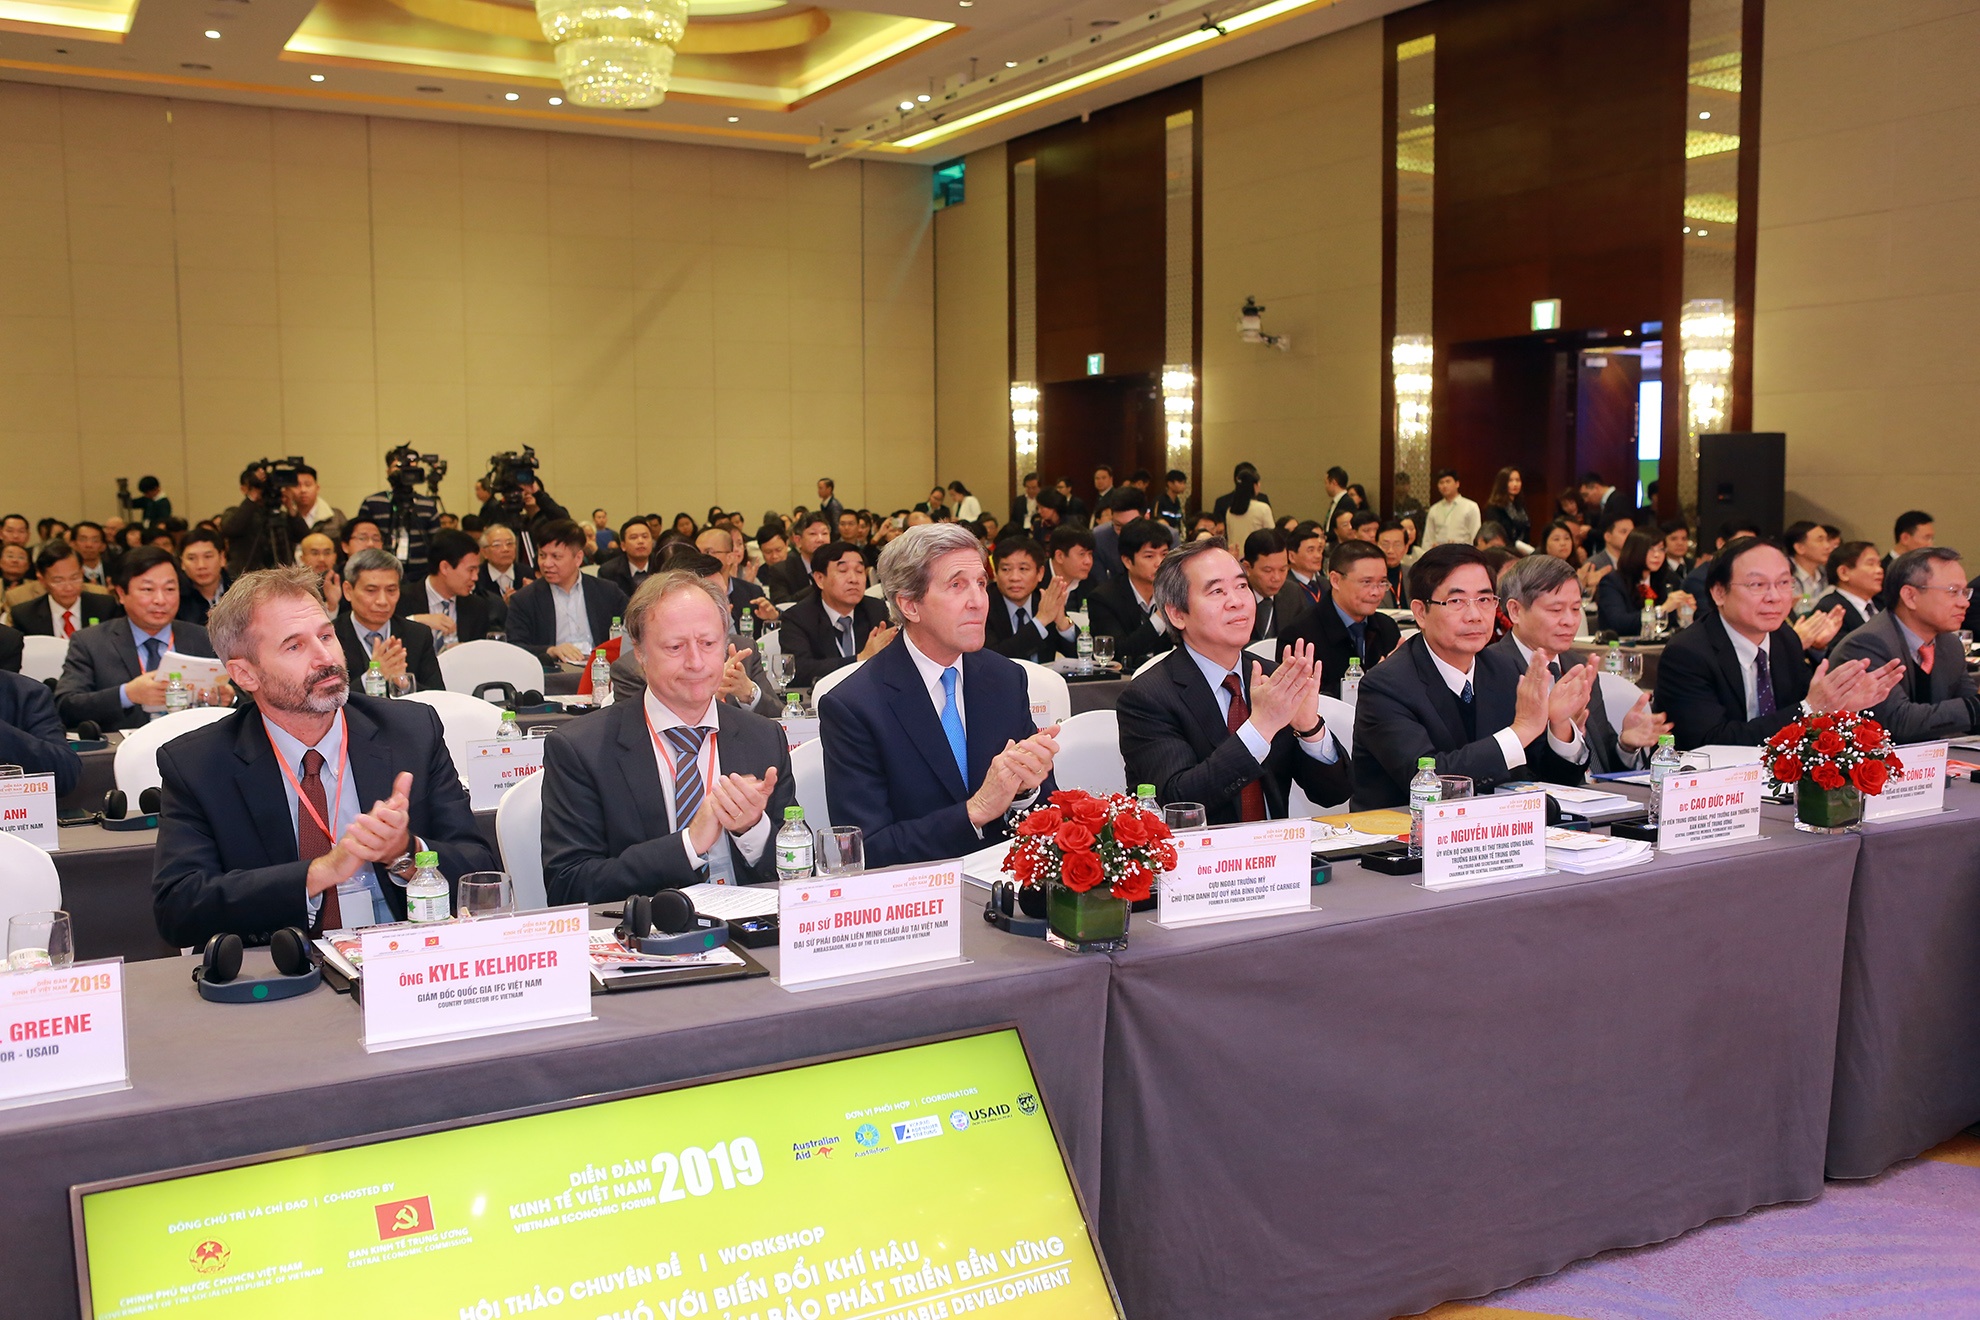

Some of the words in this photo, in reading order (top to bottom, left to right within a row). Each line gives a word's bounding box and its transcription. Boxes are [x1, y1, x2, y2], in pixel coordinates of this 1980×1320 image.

[23, 782, 48, 793] 2019
[4, 808, 27, 820] ANH
[1523, 798, 1541, 810] 2019
[1690, 798, 1706, 810] CAO
[1283, 827, 1305, 840] 2019
[1451, 823, 1488, 843] NGUYỄN
[1491, 823, 1509, 838] VĂN
[1512, 820, 1533, 836] BÌNH
[1198, 865, 1212, 875] ÔNG
[1215, 859, 1242, 873] JOHN
[1246, 855, 1276, 870] KERRY
[928, 872, 955, 887] 2019
[1277, 882, 1300, 891] CARNEGIE
[548, 917, 580, 935] 2019
[799, 922, 815, 935] ĐẠI
[818, 917, 831, 931] SỨ
[834, 907, 881, 928] BRUNO
[886, 899, 944, 921] ANGELET
[866, 930, 882, 938] MINH
[884, 926, 900, 936] CHÂU
[921, 921, 934, 930] VIỆT
[935, 920, 948, 928] NAM
[880, 934, 905, 944] DELEGATION
[399, 972, 423, 987] ÔNG
[429, 962, 469, 983] KYLE
[475, 950, 558, 977] KELHOFER
[70, 973, 111, 993] 2019
[417, 990, 438, 1002] GIÁM
[440, 988, 455, 1000] ĐỐC
[457, 985, 478, 998] QUỐC
[480, 985, 492, 995] GIA
[494, 983, 506, 992] IFC
[507, 979, 523, 991] VIỆT
[525, 978, 542, 988] NAM
[438, 1000, 462, 1009] COUNTRY
[463, 996, 490, 1006] DIRECTOR
[500, 991, 523, 1000] VIETNAM
[10, 1013, 91, 1042] GREENE
[26, 1045, 59, 1058] USAID
[845, 1108, 864, 1120] ĐƠN
[921, 1087, 978, 1105] COORDINATORS
[969, 1103, 1011, 1121] USAID
[793, 1136, 840, 1151] Australian
[795, 1150, 811, 1161] Aid
[569, 1164, 608, 1187] DIỄN
[611, 1159, 647, 1179] ĐÀN
[651, 1136, 764, 1204] 2019
[248, 1206, 263, 1219] VÀ
[285, 1199, 308, 1213] ĐẠO
[323, 1185, 380, 1204] CO-HOSTED
[382, 1182, 395, 1193] BY
[508, 1198, 552, 1220] KINH
[554, 1188, 573, 1210] TẾ
[576, 1184, 609, 1206] VIỆT
[613, 1178, 652, 1198] NAM
[514, 1216, 560, 1234] VIETNAM
[562, 1204, 619, 1224] ECONOMIC
[621, 1196, 656, 1212] FORUM
[347, 1255, 381, 1268] CENTRAL
[382, 1246, 423, 1261] ECONOMIC
[425, 1237, 473, 1252] COMMISSION
[348, 1247, 369, 1260] BAN
[370, 1242, 394, 1255] KINH
[395, 1238, 406, 1250] TẾ
[408, 1233, 438, 1247] TRUNG
[213, 1272, 255, 1287] CHXHCN
[256, 1266, 277, 1279] VIỆT
[279, 1261, 303, 1273] NAM
[504, 1284, 564, 1316] THẢO
[569, 1265, 652, 1300] CHUYÊN
[718, 1226, 825, 1265] WORKSHOP
[713, 1271, 769, 1310] BIẾN
[773, 1255, 821, 1295] ĐỔI
[824, 1247, 867, 1282] KHÍ
[870, 1239, 920, 1271] HẬU
[825, 1279, 886, 1315] PHÁT
[890, 1257, 953, 1298] TRIỂN
[956, 1248, 999, 1281] BỀN
[1001, 1236, 1065, 1268] VỮNG
[175, 1296, 189, 1304] THE
[192, 1288, 233, 1302] SOCIALIST
[235, 1278, 272, 1292] REPUBLIC
[275, 1275, 286, 1284] OF
[288, 1267, 324, 1281] VIETNAM
[950, 1268, 1070, 1315] DEVELOPMENT
